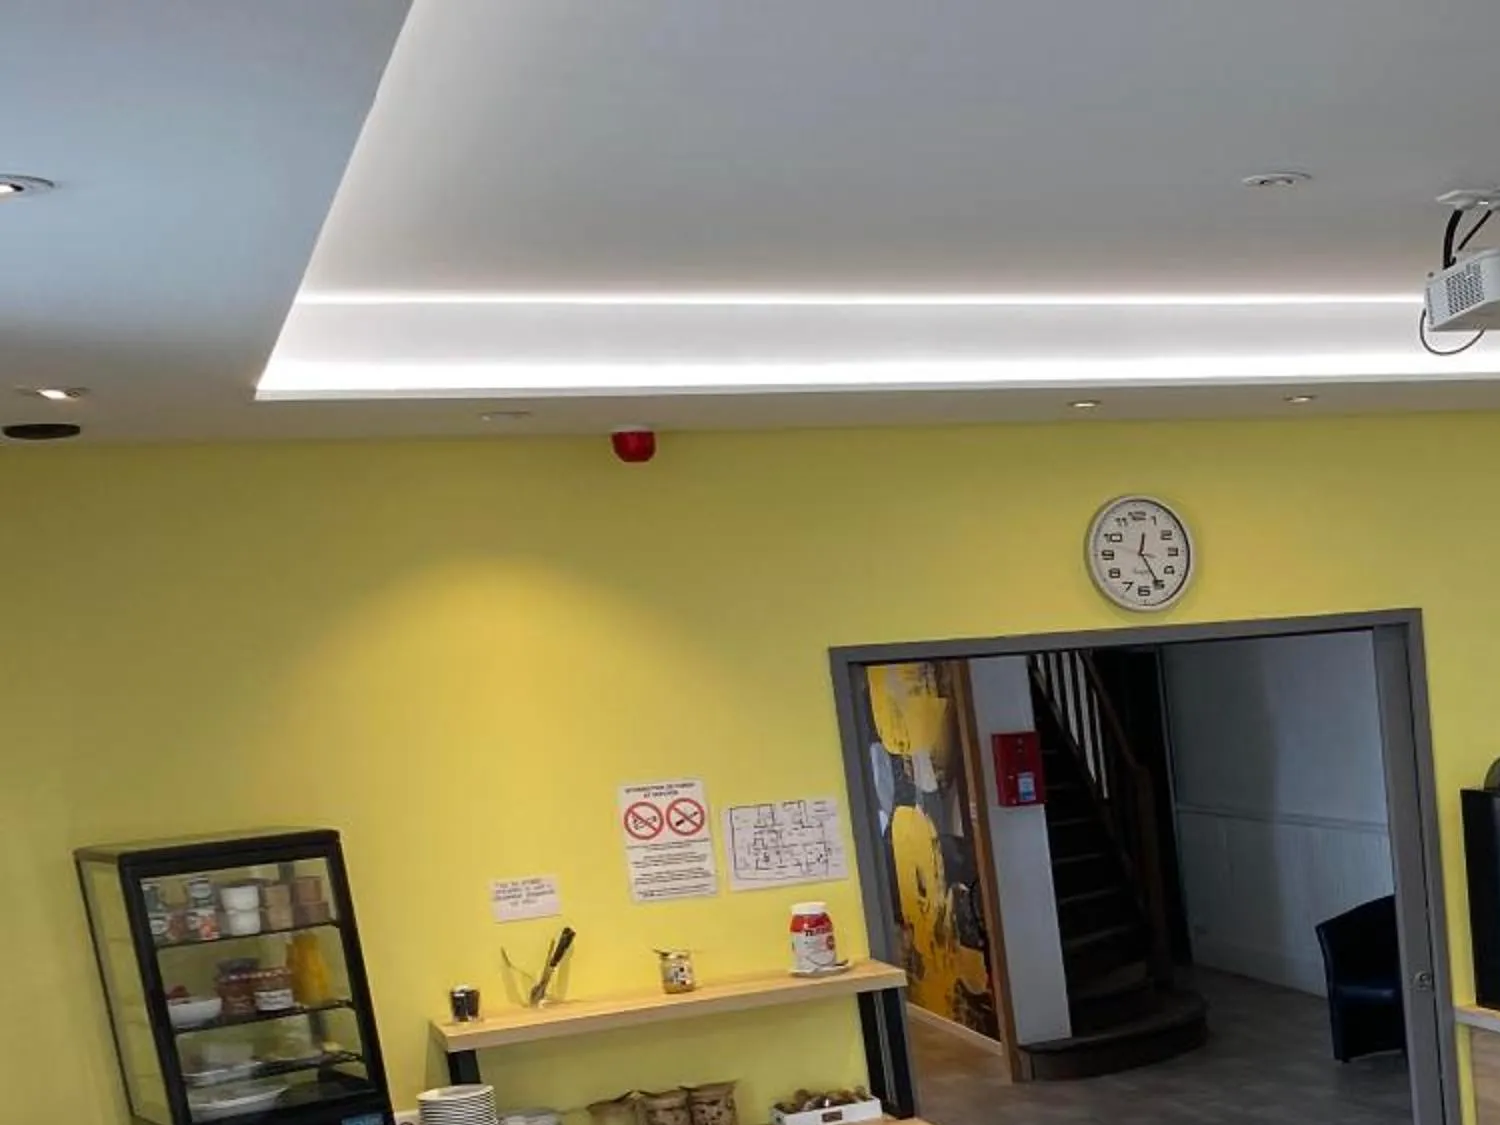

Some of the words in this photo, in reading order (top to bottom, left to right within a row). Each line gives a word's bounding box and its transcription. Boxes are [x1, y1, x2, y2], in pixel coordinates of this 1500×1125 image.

[1115, 517, 1128, 527] 11
[1151, 515, 1157, 526] 1
[1103, 532, 1123, 543] 10
[1161, 529, 1173, 541] 2
[1101, 549, 1115, 561] 9
[1167, 547, 1179, 557] 3
[1108, 567, 1121, 579] 8
[1163, 565, 1175, 575] 4
[1121, 580, 1134, 592] 7
[1137, 585, 1151, 597] 6
